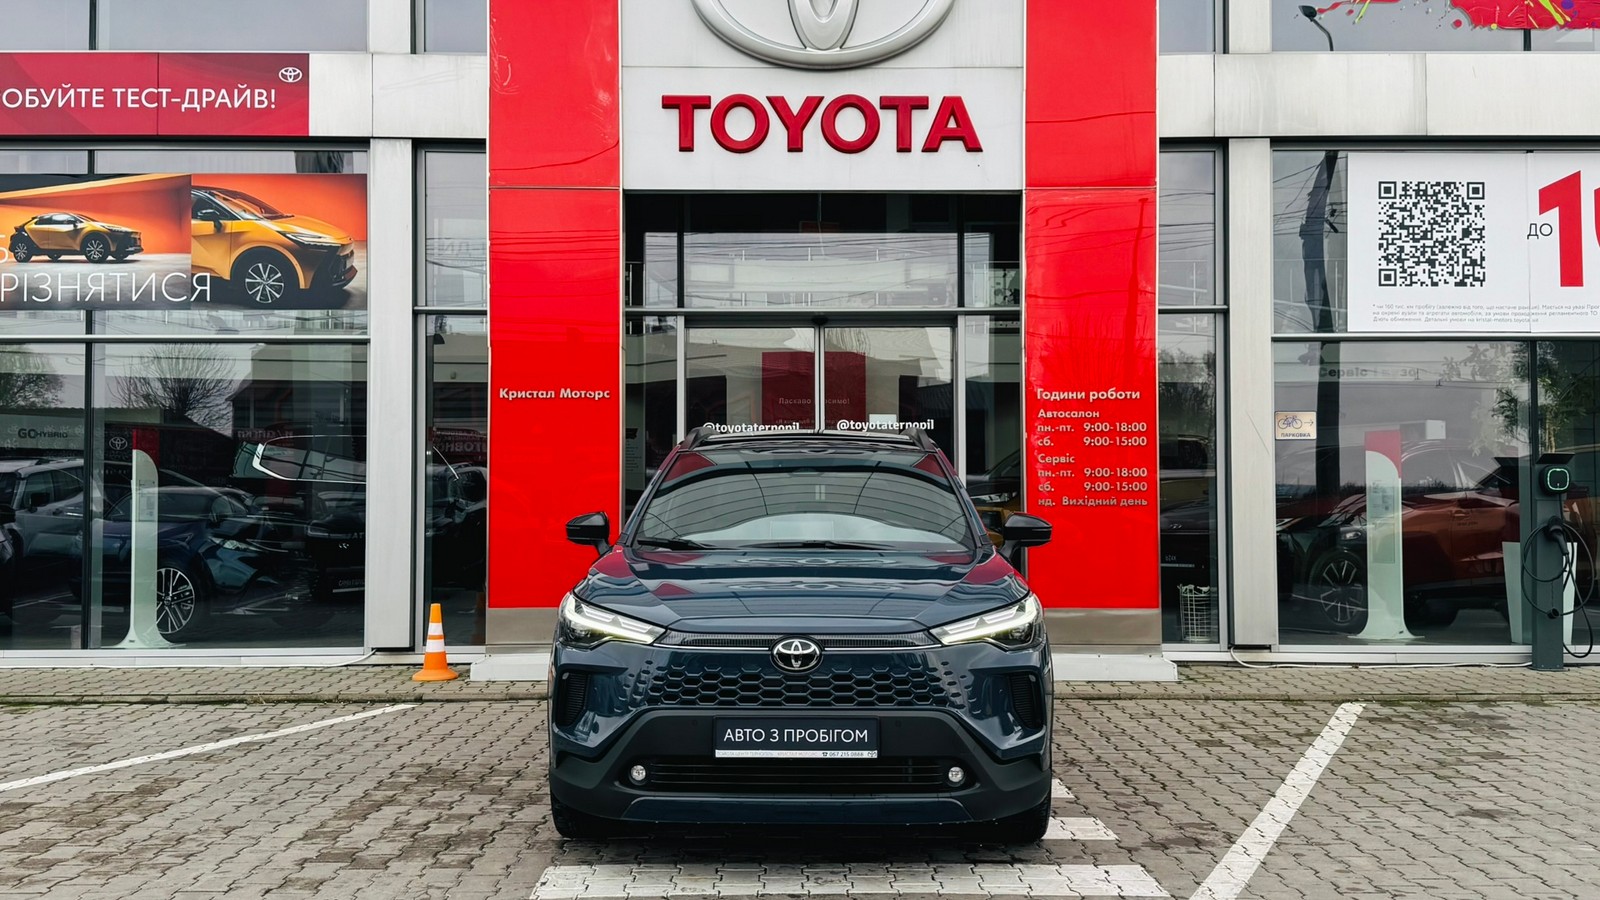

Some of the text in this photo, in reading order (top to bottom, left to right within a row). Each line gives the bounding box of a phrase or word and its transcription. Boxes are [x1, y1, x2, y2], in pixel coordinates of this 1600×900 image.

[112, 84, 276, 112] ТЕСТ-ДРАЙВ!
[661, 94, 983, 154] TOYOTA
[1527, 170, 1600, 287] ДО 1
[1, 272, 211, 302] РІЗНЯТИСЯ
[499, 388, 610, 400] Кристал Моторс
[1037, 387, 1140, 402] Години роботи
[1037, 408, 1100, 418] Автосалон
[1037, 422, 1147, 432] пн.-пт. 9:00-18:00
[1037, 436, 1147, 446] сб. 9:00-15:00
[1038, 453, 1075, 465] Сервіс
[1038, 467, 1148, 477] пн.-пт. 9:00-18:00
[1038, 481, 1148, 491] сб. 9:00-15:00
[1038, 495, 1148, 507] нд. Вихідний день
[723, 728, 868, 743] АВТО З ПРОБІГОМ
